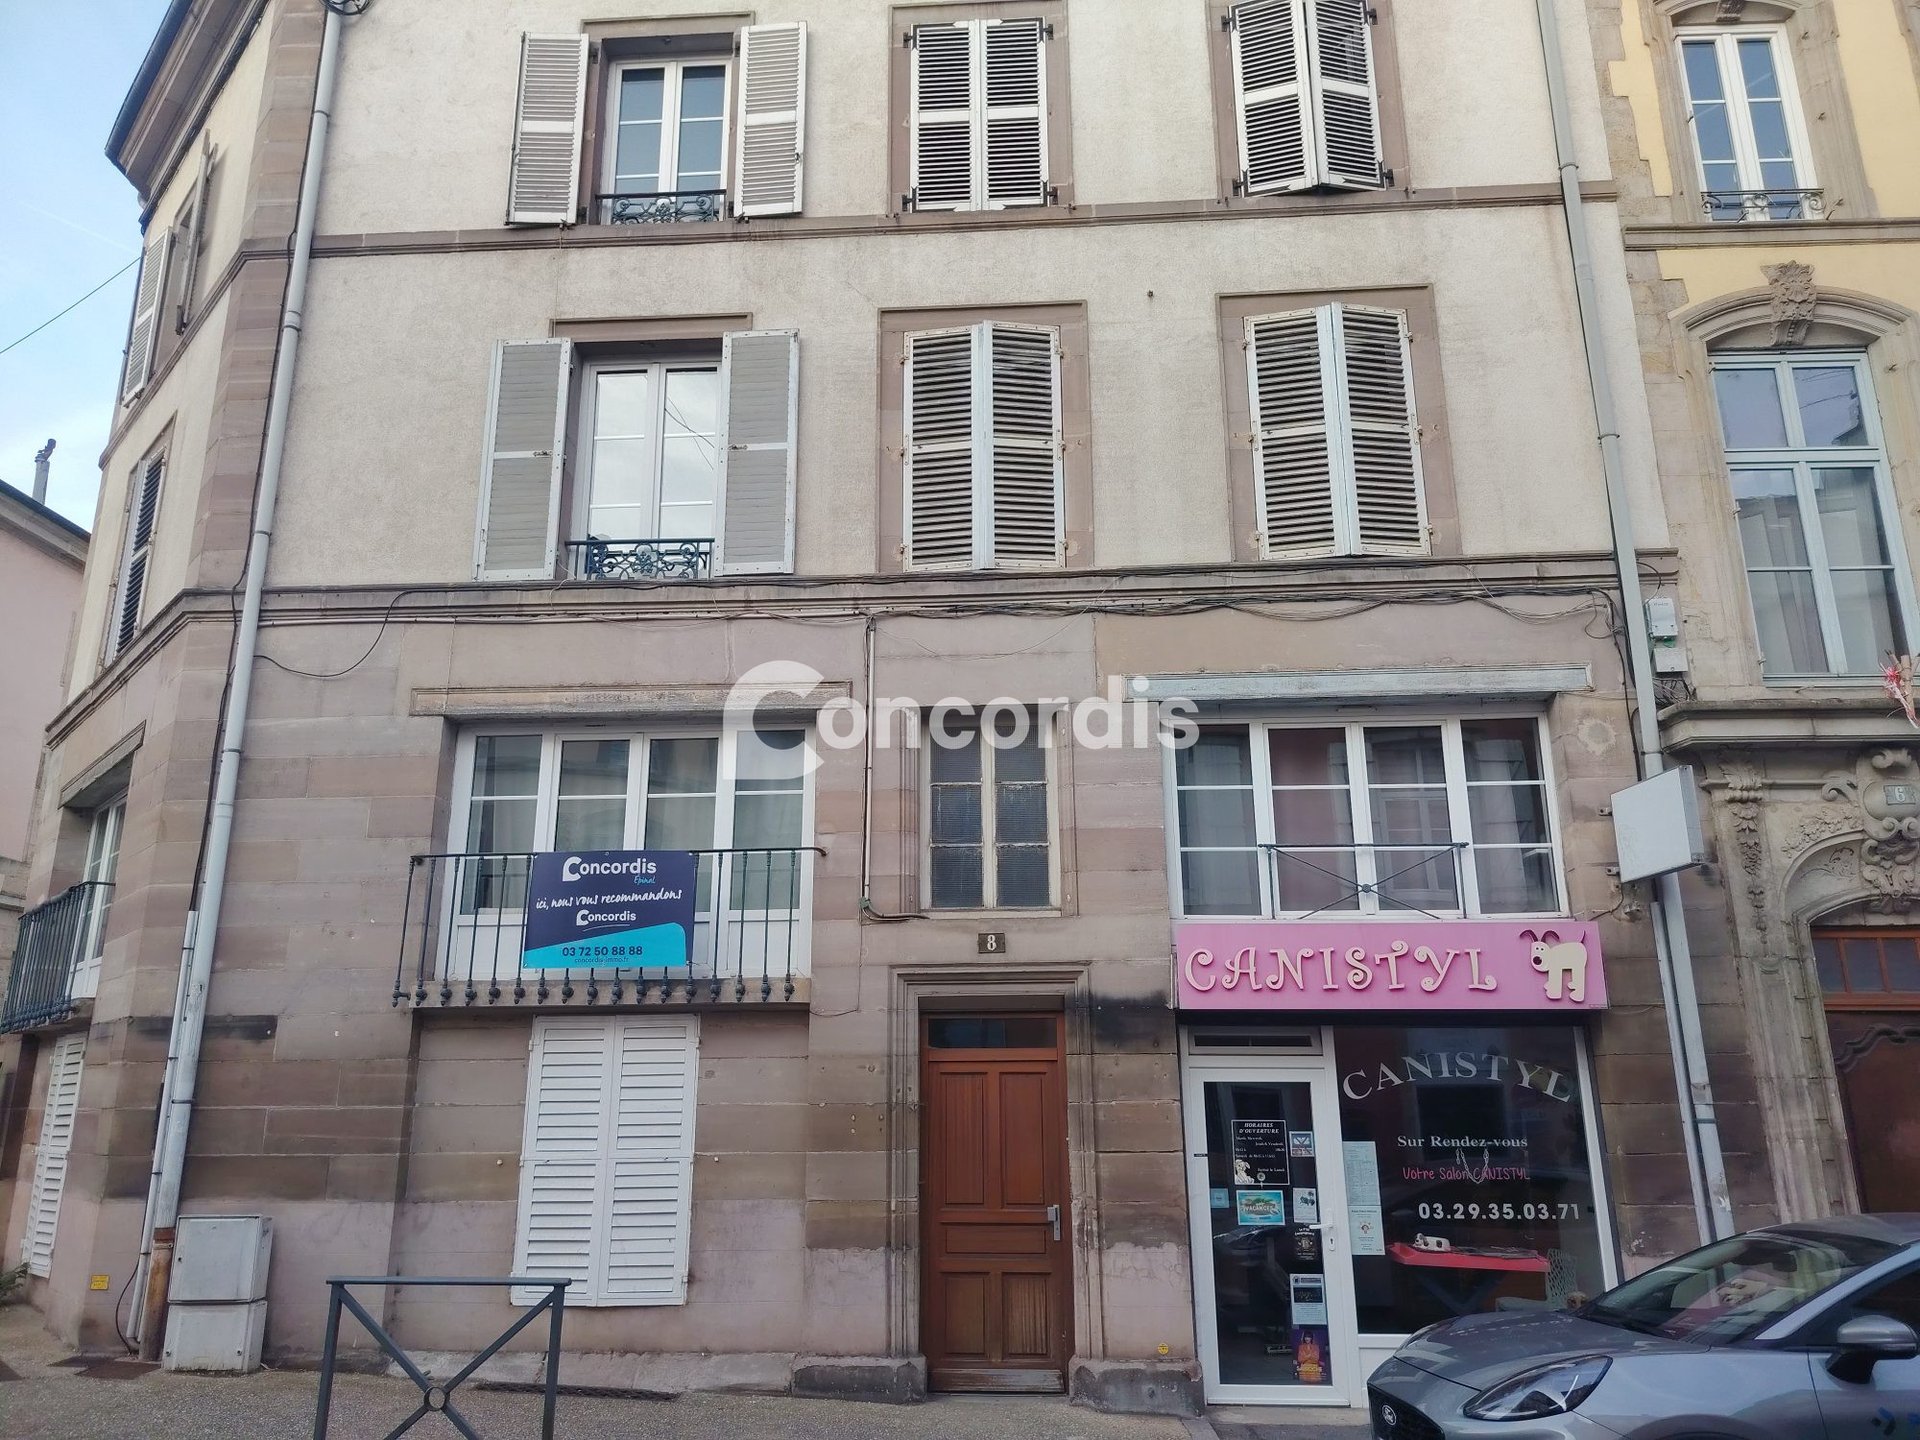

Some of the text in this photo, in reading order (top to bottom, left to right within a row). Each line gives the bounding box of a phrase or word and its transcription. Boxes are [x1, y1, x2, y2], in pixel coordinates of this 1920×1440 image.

[1895, 786, 1906, 801] 6
[562, 856, 657, 882] Concordis
[536, 887, 682, 910] ici, nous vous recommandons
[576, 909, 637, 926] Concordis
[562, 945, 643, 956] 03 72 50 88 88
[987, 934, 997, 951] 8
[1184, 940, 1498, 992] CANISTYL
[1342, 1051, 1572, 1103] CANISTYL
[1397, 1135, 1528, 1147] Sur Rendez-vous
[1402, 1167, 1531, 1180] Votre Salon CANISTYL
[1418, 1203, 1580, 1220] 03.29.35.03.71
